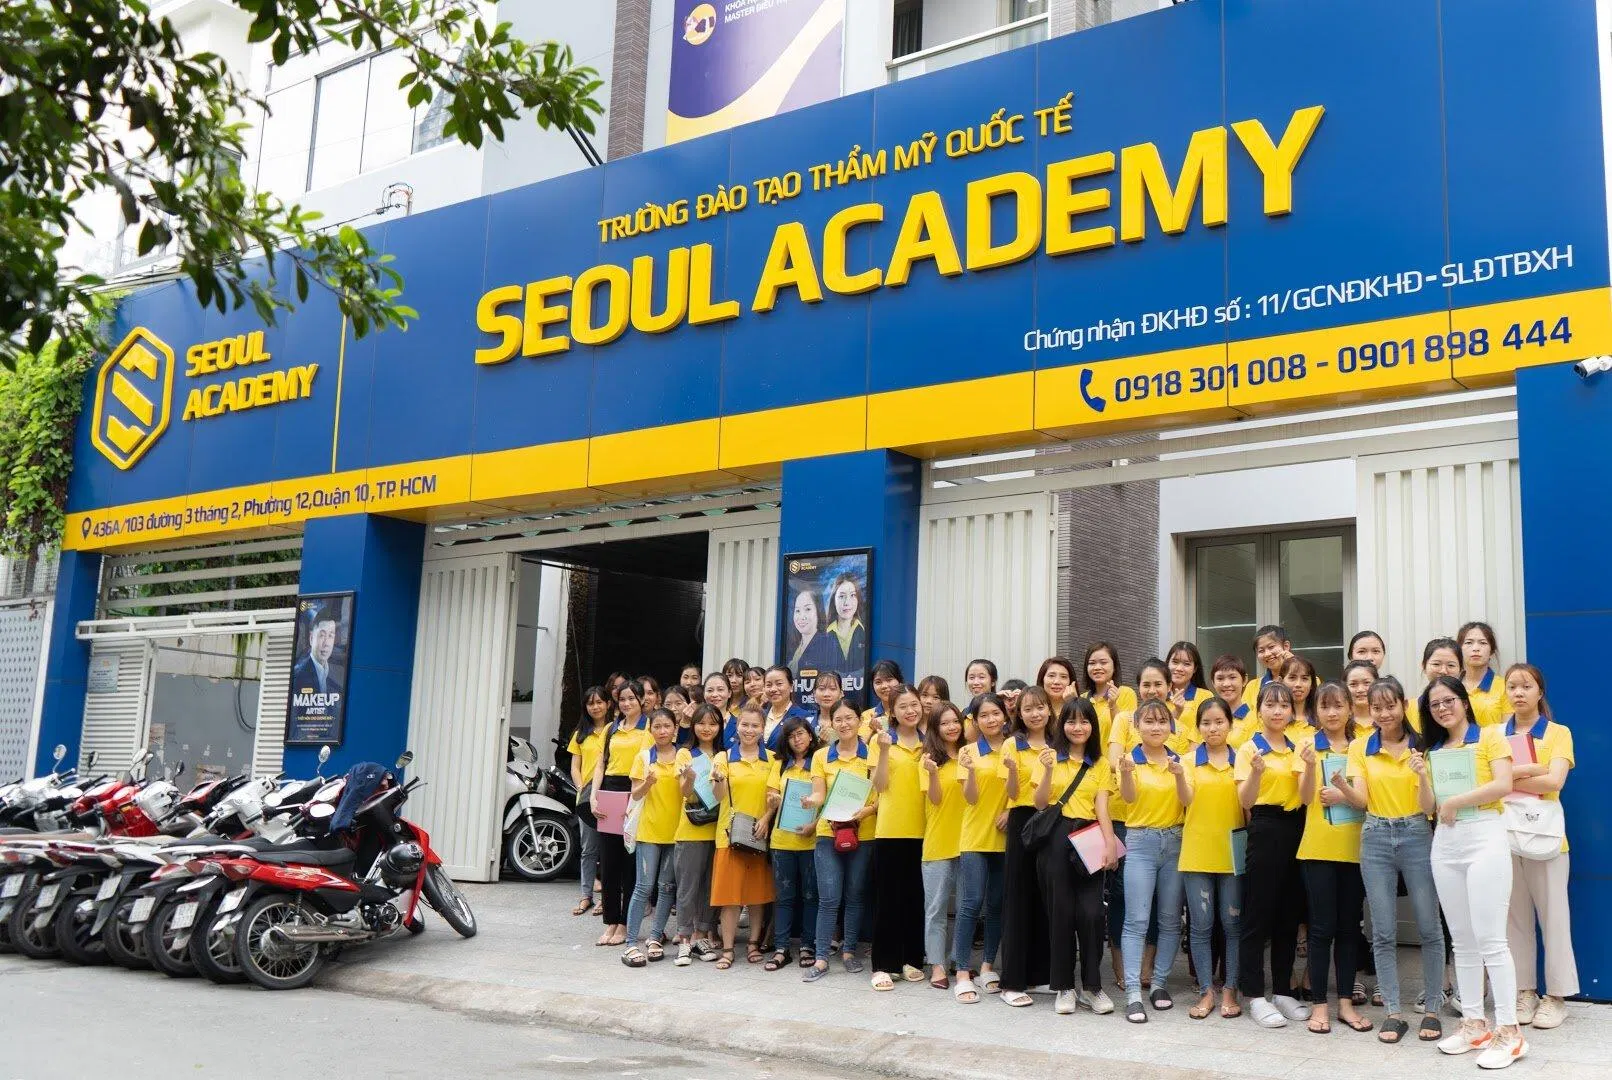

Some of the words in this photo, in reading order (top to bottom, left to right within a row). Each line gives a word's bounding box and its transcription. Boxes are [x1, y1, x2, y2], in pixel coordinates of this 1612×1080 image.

[724, 6, 755, 23] MASTER
[598, 199, 689, 243] TRƯỜNG
[696, 184, 748, 220] ĐÀO
[754, 171, 802, 205] TẠO
[808, 144, 887, 191] THẨM
[894, 131, 938, 171] MỸ
[945, 107, 1025, 158] QUỐC
[1033, 91, 1075, 136] TẾ
[475, 242, 740, 366] SEOUL
[751, 104, 1326, 314] ACADEMY
[185, 330, 272, 378] SEOUL
[1023, 326, 1083, 351] Chứng
[1087, 317, 1135, 342] nhận
[1141, 305, 1208, 334] ĐKHĐ
[1114, 370, 1182, 402] 0918
[1189, 362, 1239, 393] 301
[1247, 353, 1307, 386] 008
[1337, 338, 1415, 374] 0901
[1424, 327, 1489, 362] 898
[1502, 316, 1573, 351] 444
[182, 363, 319, 421] ACADEMY
[92, 515, 144, 537] 436A/103
[146, 512, 183, 531] đường
[185, 507, 193, 524] 3
[194, 506, 229, 525] tháng
[243, 495, 292, 517] Phường
[400, 474, 437, 495] HCM
[293, 692, 340, 707] MAKEUP
[305, 707, 326, 715] ARTIST
